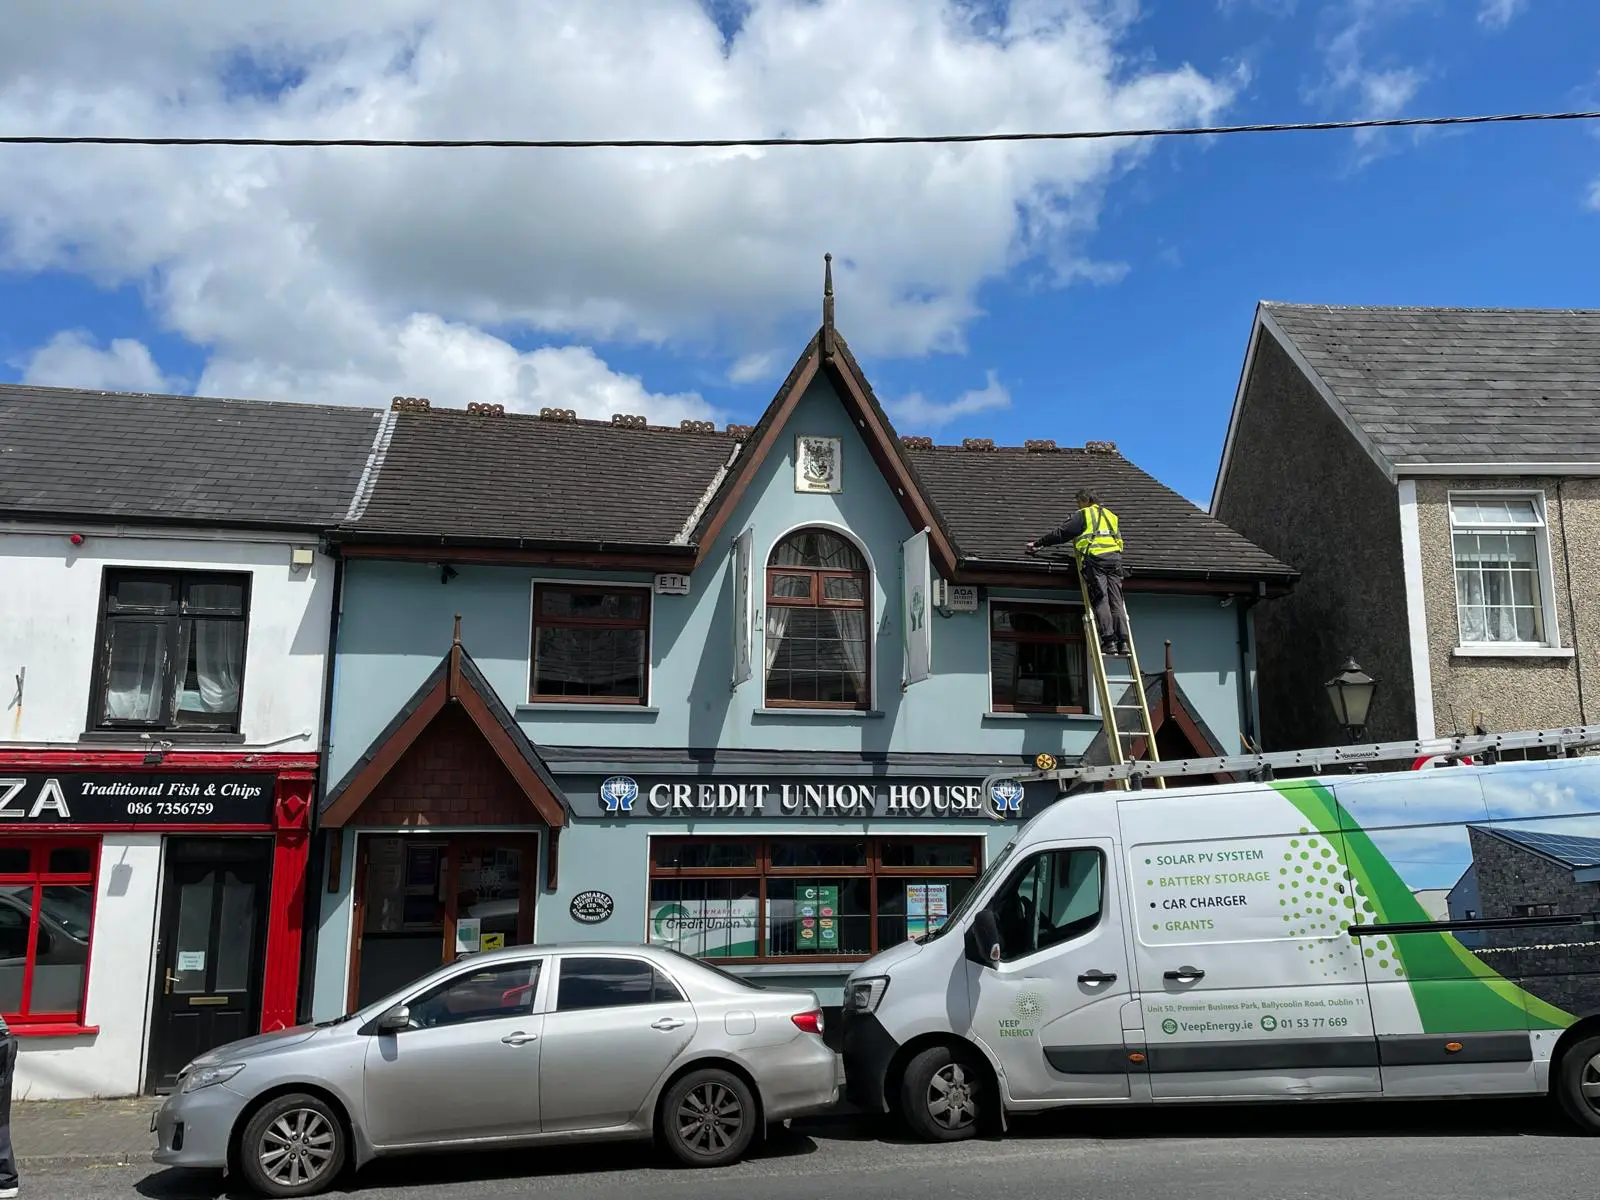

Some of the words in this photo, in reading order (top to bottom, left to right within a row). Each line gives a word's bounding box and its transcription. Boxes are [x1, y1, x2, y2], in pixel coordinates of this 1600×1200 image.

[660, 576, 687, 587] ETL
[81, 782, 163, 796] Traditional
[167, 783, 200, 796] Fish
[203, 783, 217, 796] &
[220, 784, 262, 800] Chips
[649, 783, 770, 808] CREDIT
[781, 784, 878, 809] UNION
[888, 785, 982, 809] HOUSE
[127, 802, 152, 815] 086
[156, 802, 214, 815] 7356759
[1157, 855, 1195, 865] SOLAR
[1199, 853, 1213, 863] PV
[1217, 850, 1264, 861] SYSTEM
[1160, 876, 1210, 887] BATTERY
[1215, 872, 1270, 884] STORAGE
[1163, 899, 1187, 909] CAR
[1190, 895, 1247, 908] CHARGER
[666, 919, 704, 929] Credit
[706, 918, 741, 929] Union
[1165, 920, 1214, 931] GRANTS
[1148, 1005, 1163, 1013] Unit
[1164, 1005, 1176, 1013] 50,
[1178, 1003, 1206, 1012] Premier
[1208, 1002, 1239, 1011] Business
[1241, 1002, 1260, 1010] Park,
[1262, 1001, 1303, 1010] Ballycoolin
[1305, 1000, 1326, 1008] Road,
[1328, 998, 1354, 1006] Dublin
[998, 1020, 1020, 1028] VEEP
[1180, 1020, 1253, 1033] VeepEnergy.ie
[1281, 1019, 1293, 1028] 01
[1297, 1019, 1309, 1028] 53
[1312, 1018, 1324, 1027] 77
[1328, 1017, 1348, 1027] 669
[1000, 1029, 1034, 1037] ENERGY
